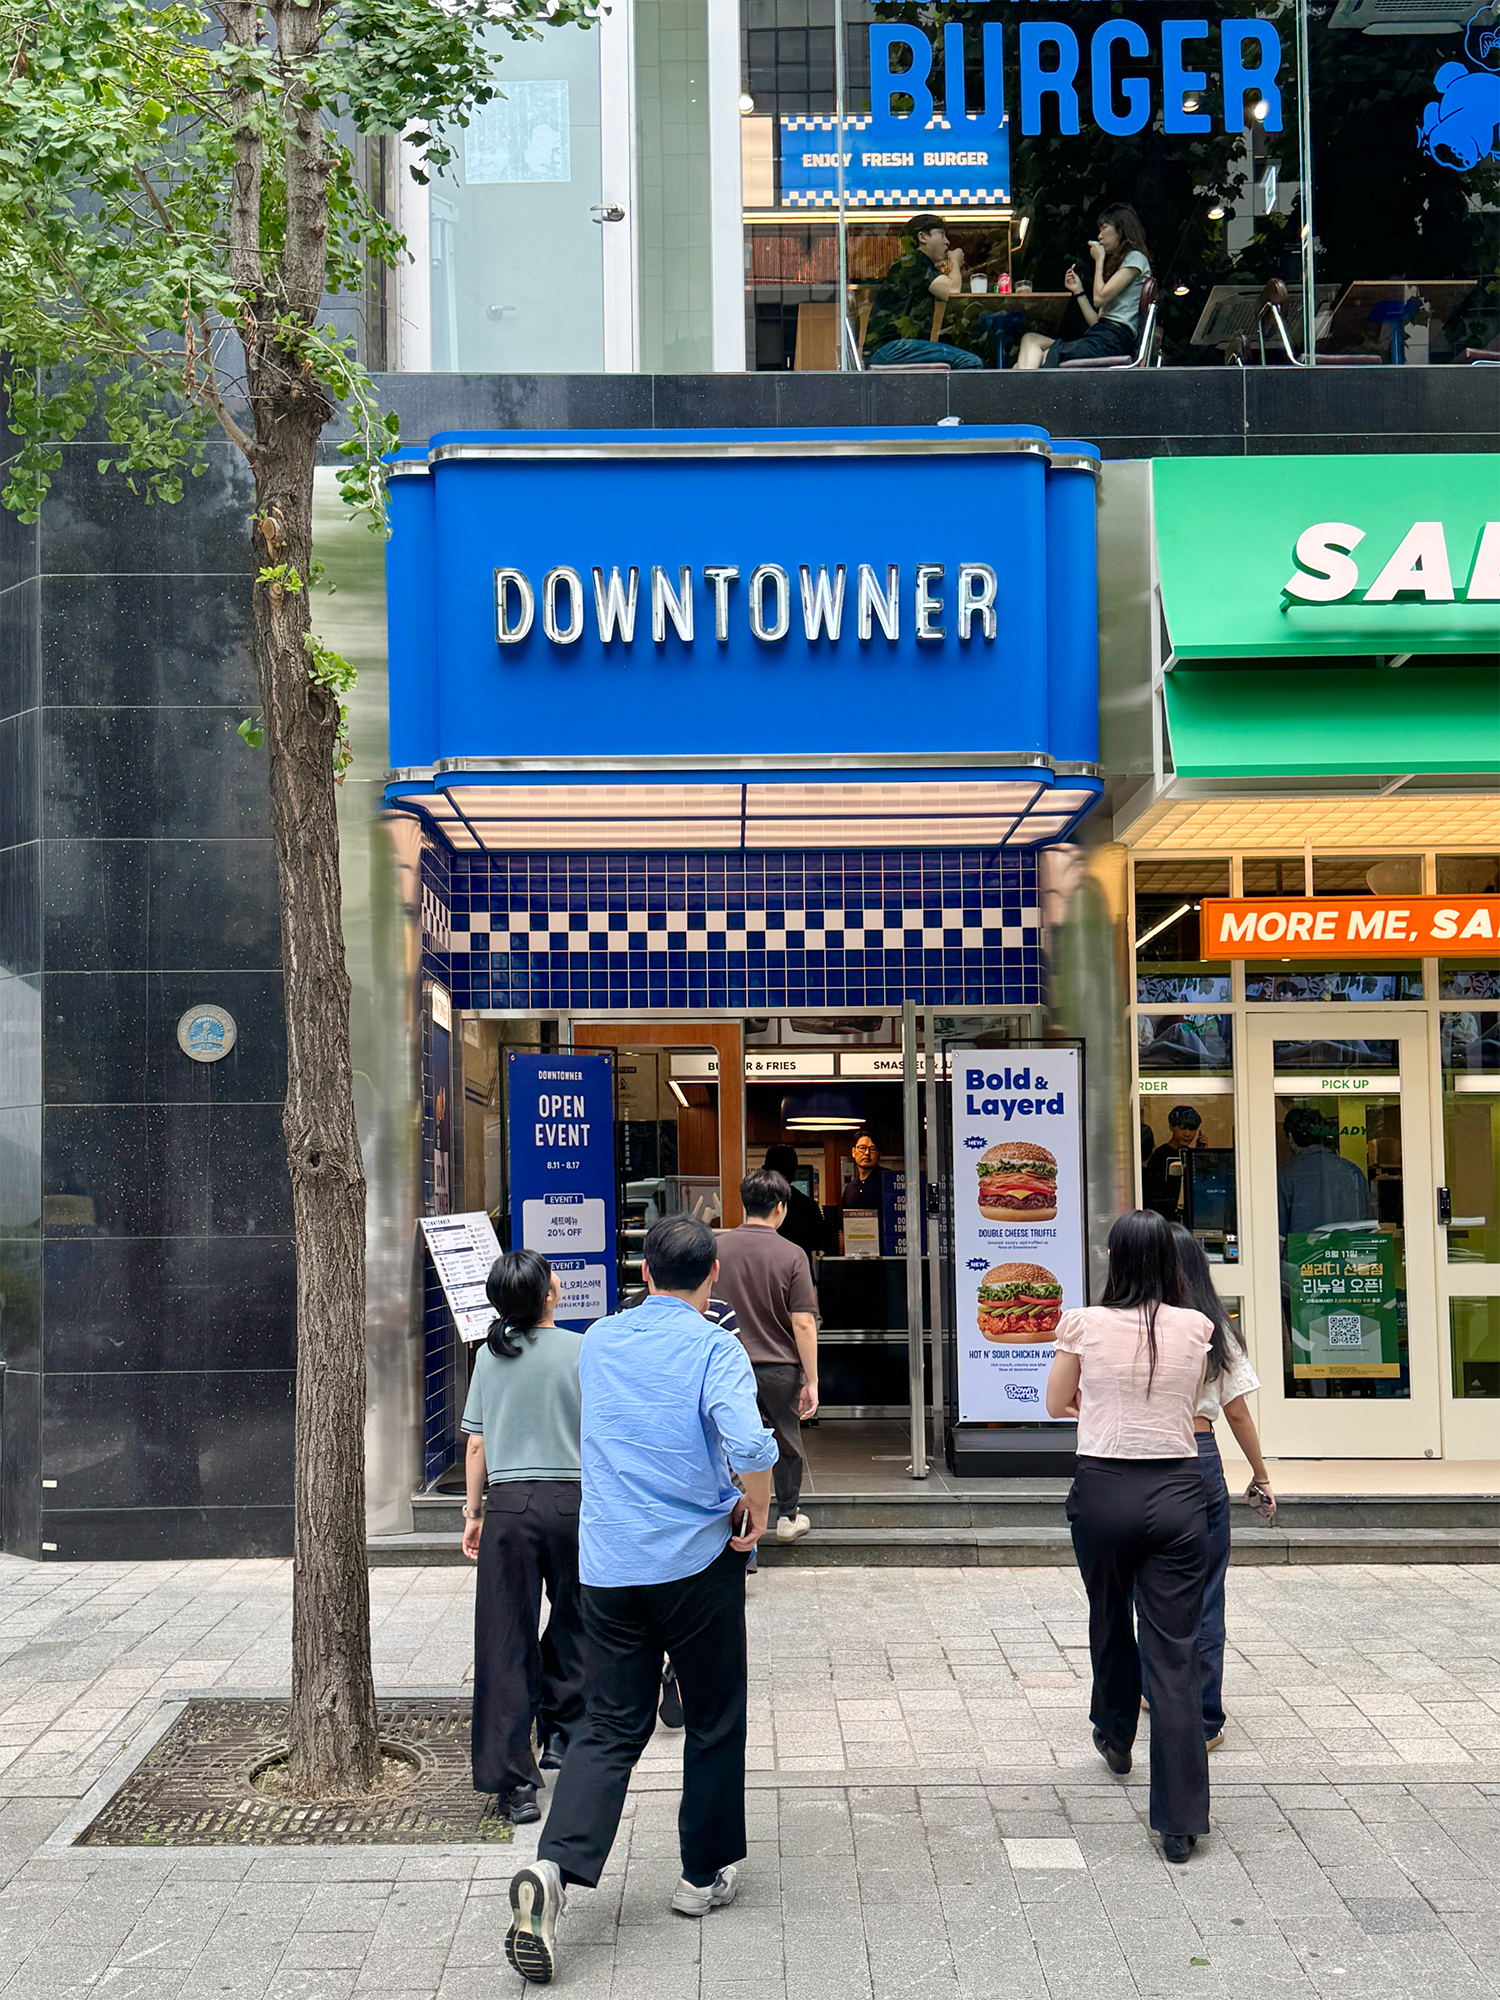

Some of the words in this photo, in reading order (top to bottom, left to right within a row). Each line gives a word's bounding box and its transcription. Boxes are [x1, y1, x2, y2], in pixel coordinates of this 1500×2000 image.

[869, 19, 1283, 136] BURGER
[802, 153, 852, 168] ENJOY
[862, 152, 914, 167] FRESH
[923, 151, 988, 166] BURGER
[493, 563, 998, 644] DOWNTOWNER
[1219, 911, 1339, 942] MORE
[1347, 910, 1418, 942] ME,
[1430, 908, 1500, 939] SA
[755, 1061, 763, 1070] &
[766, 1061, 797, 1070] FRIES
[538, 1070, 583, 1081] DOWNTOWNER
[966, 1067, 1031, 1090] Bold
[1034, 1076, 1049, 1090] &
[1138, 1081, 1168, 1091] RDER
[1321, 1079, 1350, 1090] PICK
[1353, 1079, 1369, 1089] UP
[538, 1094, 585, 1118] OPEN
[966, 1092, 1064, 1121] Layerd
[535, 1123, 591, 1147] EVENT
[546, 1161, 560, 1170] 8.11
[566, 1161, 580, 1170] 8.17
[549, 1195, 573, 1204] EVENT
[574, 1195, 579, 1203] 1
[550, 1216, 579, 1226] 세트메뉴
[547, 1228, 566, 1237] 20%
[566, 1228, 582, 1237] OFF
[978, 1228, 1003, 1238] DOUBLE
[1004, 1228, 1029, 1238] CHEESE
[1030, 1228, 1057, 1238] TRUFFLE
[1324, 1250, 1339, 1258] 8월
[1341, 1250, 1358, 1258] 11일
[550, 1261, 574, 1270] EVENT
[575, 1261, 580, 1270] 2
[1300, 1263, 1340, 1277] 샐러디
[560, 1279, 601, 1291] 너_오피스어택
[1302, 1278, 1346, 1294] 리뉴얼
[1350, 1278, 1383, 1293] 오픈!
[968, 1349, 982, 1359] HOT
[992, 1349, 1010, 1359] SOUR
[1011, 1349, 1040, 1359] CHICKEN
[1041, 1349, 1057, 1359] AVO
